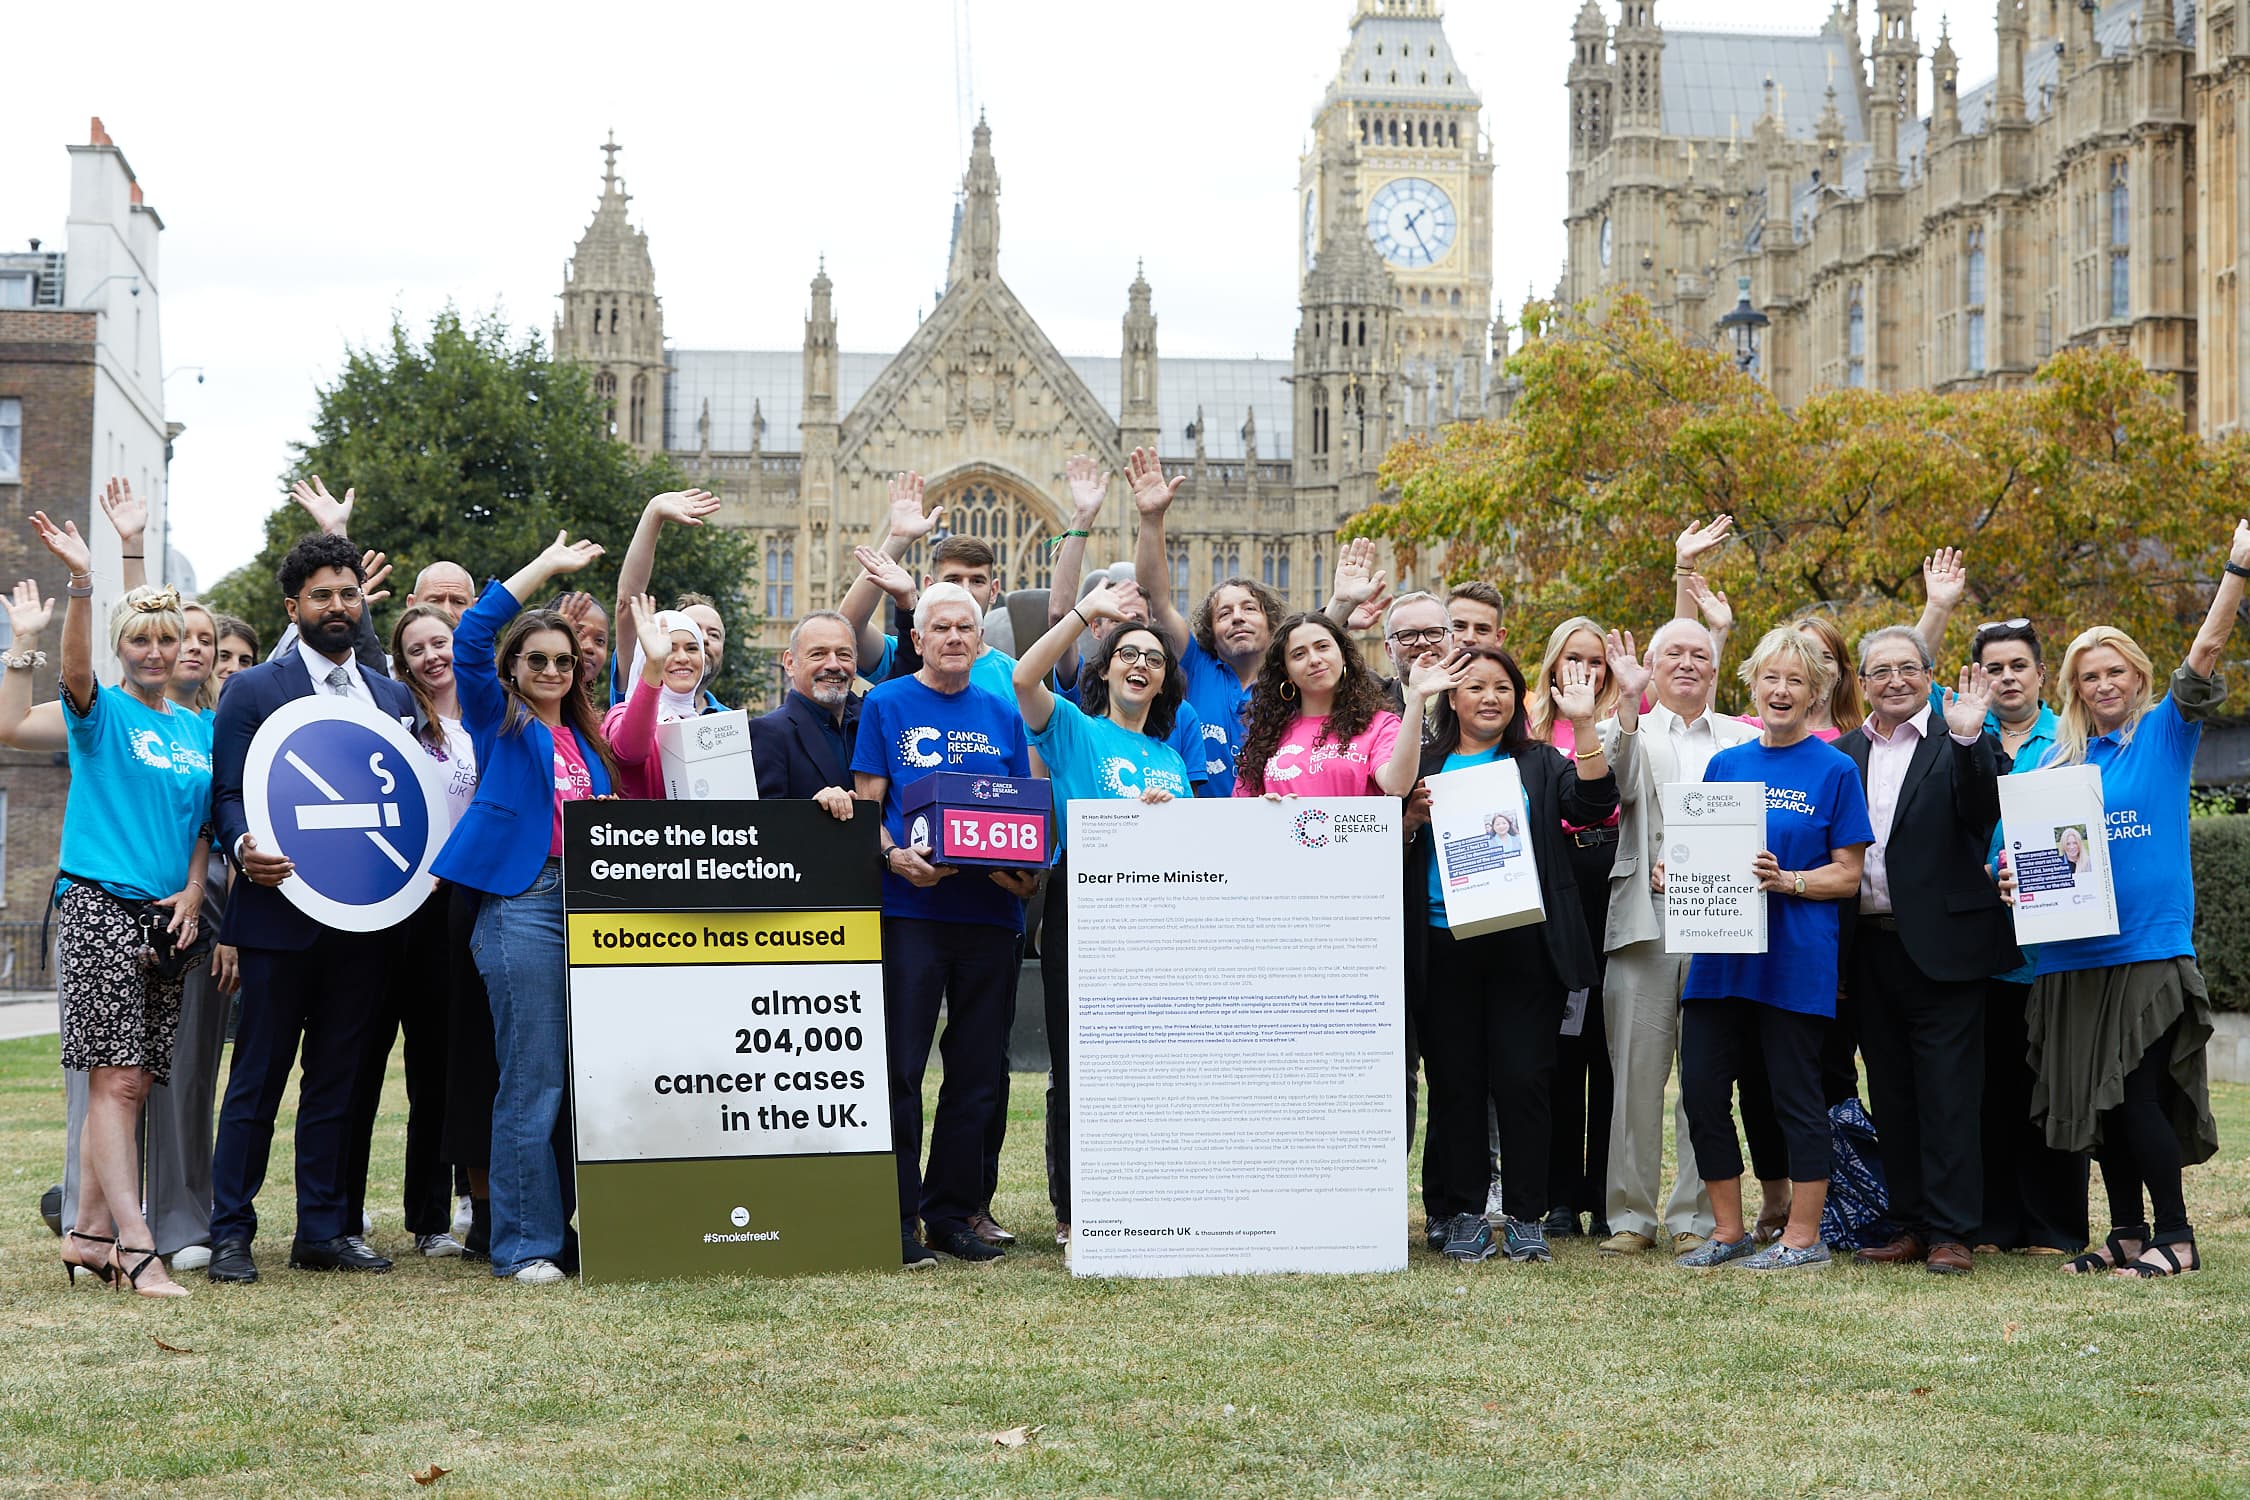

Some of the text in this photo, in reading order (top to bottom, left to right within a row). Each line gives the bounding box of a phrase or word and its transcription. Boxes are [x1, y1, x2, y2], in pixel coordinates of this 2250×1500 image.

[714, 725, 732, 733] CANCER
[714, 731, 739, 739] RESEARCH
[947, 731, 989, 744] CANCER
[947, 742, 1001, 756] RESEARCH
[1311, 742, 1358, 755] CANCR
[947, 754, 963, 764] UK
[1310, 750, 1368, 765] RESEARCH
[173, 764, 192, 775] UK
[1309, 762, 1324, 775] UK
[1142, 767, 1182, 784] CANCER
[449, 784, 468, 798] UK
[1765, 799, 1816, 816] ESEARCH
[1334, 815, 1376, 823] CANCER
[590, 822, 758, 846] Since the last
[1334, 824, 1388, 833] RESEARCH
[950, 820, 1038, 851] 13,618
[1334, 834, 1349, 843] UK
[590, 856, 802, 882] General Election,
[1078, 870, 1228, 884] Dear Prime Minister,
[1668, 872, 1731, 885] The biggest
[1703, 884, 1714, 894] of
[1717, 886, 1754, 894] cancer
[1669, 896, 1688, 905] has
[1708, 895, 1737, 908] place
[1669, 906, 1742, 916] in our future.
[592, 926, 844, 948] tobacco has caused
[1680, 928, 1753, 937] #SmokefreeUK
[752, 990, 862, 1016] almost
[736, 1026, 862, 1056] 204,000
[654, 1070, 864, 1094] cancer cases
[722, 1104, 868, 1132] in the UK.
[704, 1230, 780, 1244] #SmokefreeUK
[1082, 1228, 1122, 1237] Cancer
[1124, 1227, 1174, 1237] Research
[1176, 1227, 1191, 1236] UK
